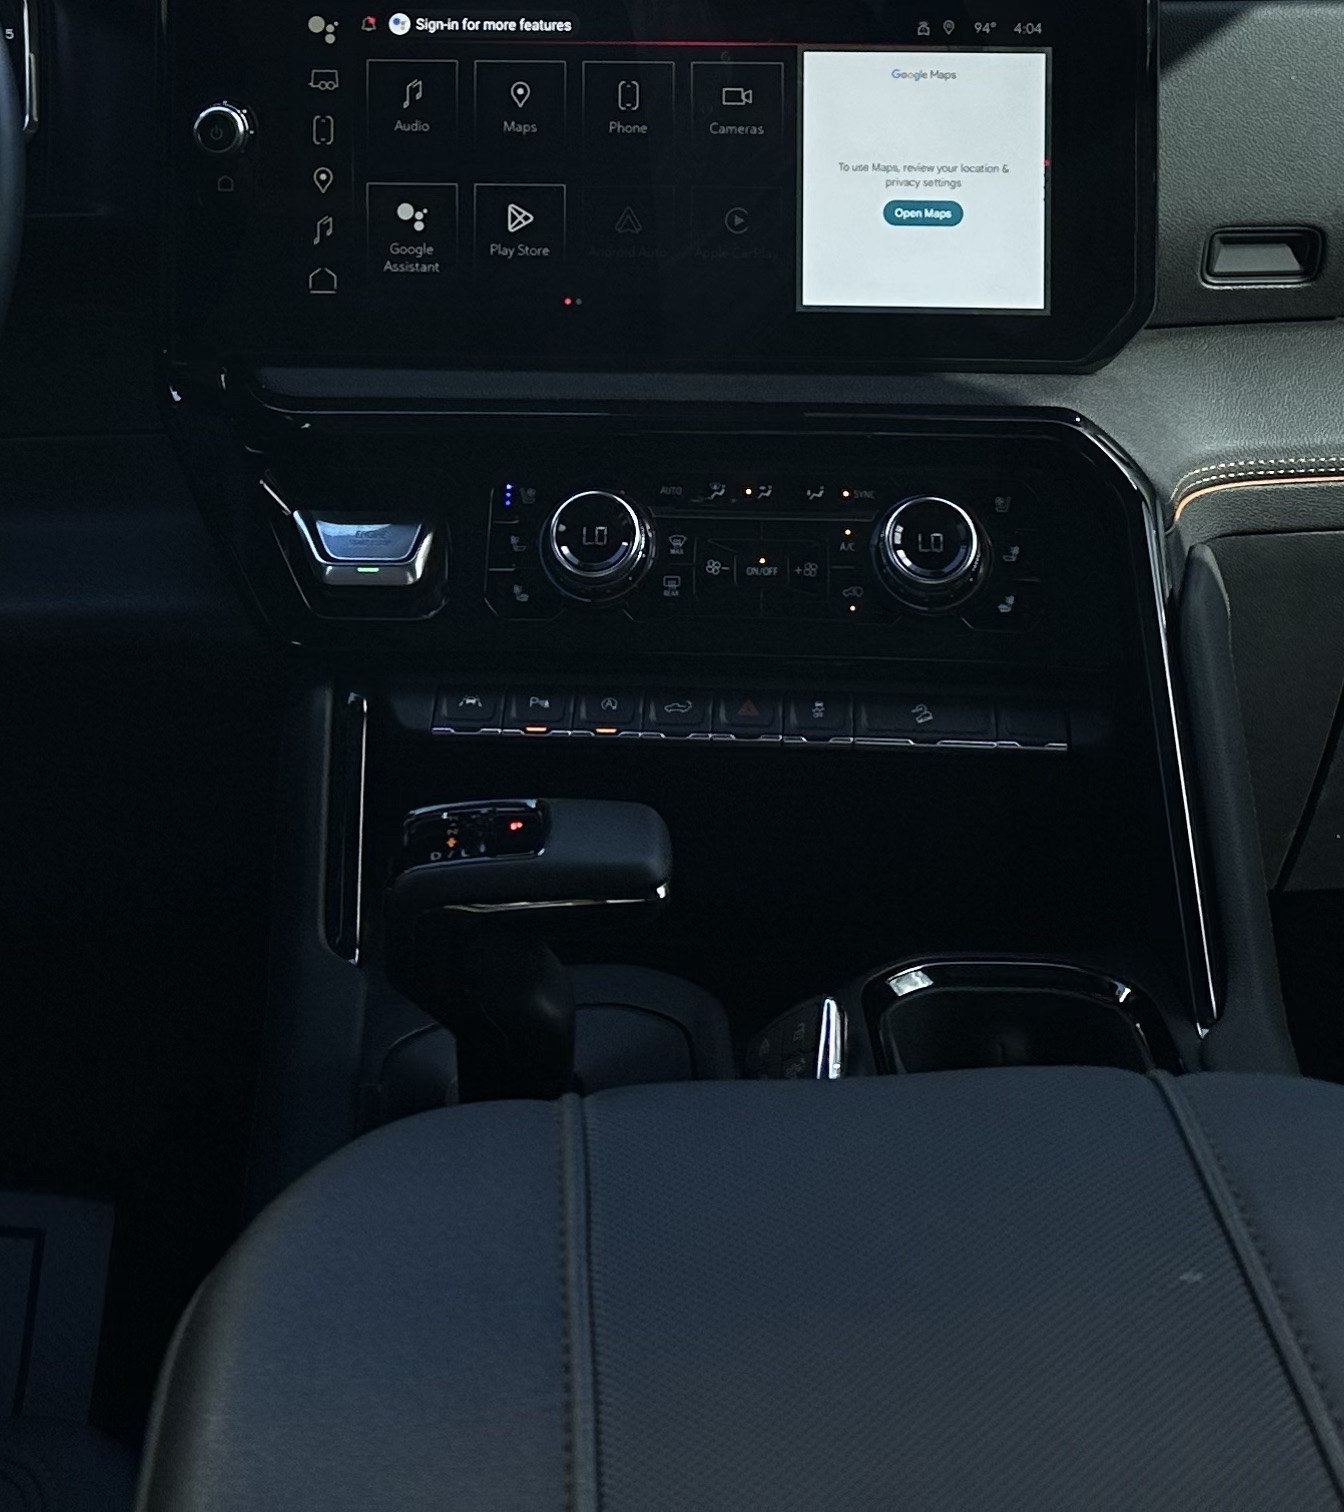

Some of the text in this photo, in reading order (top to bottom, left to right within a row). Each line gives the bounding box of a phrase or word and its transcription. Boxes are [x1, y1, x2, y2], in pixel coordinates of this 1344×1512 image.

[416, 17, 572, 34] Sign-in for more features
[973, 21, 1043, 35] 94° 4:04
[891, 68, 957, 82] Google Maps
[394, 119, 430, 133] Audio
[503, 121, 538, 136] Maps
[609, 121, 648, 134] Phone
[709, 121, 764, 136] Cameras
[839, 162, 1009, 175] To use Maps, review your location &
[885, 178, 962, 190] privacy settings
[894, 207, 952, 220] Open Maps
[389, 243, 434, 259] Google
[489, 244, 551, 259] Play Store
[383, 260, 440, 274] Assistant
[659, 486, 683, 496] AUTO
[582, 524, 608, 548] LO
[918, 532, 944, 553] LO
[839, 542, 856, 552] A/C
[746, 566, 778, 577] ON/OFF
